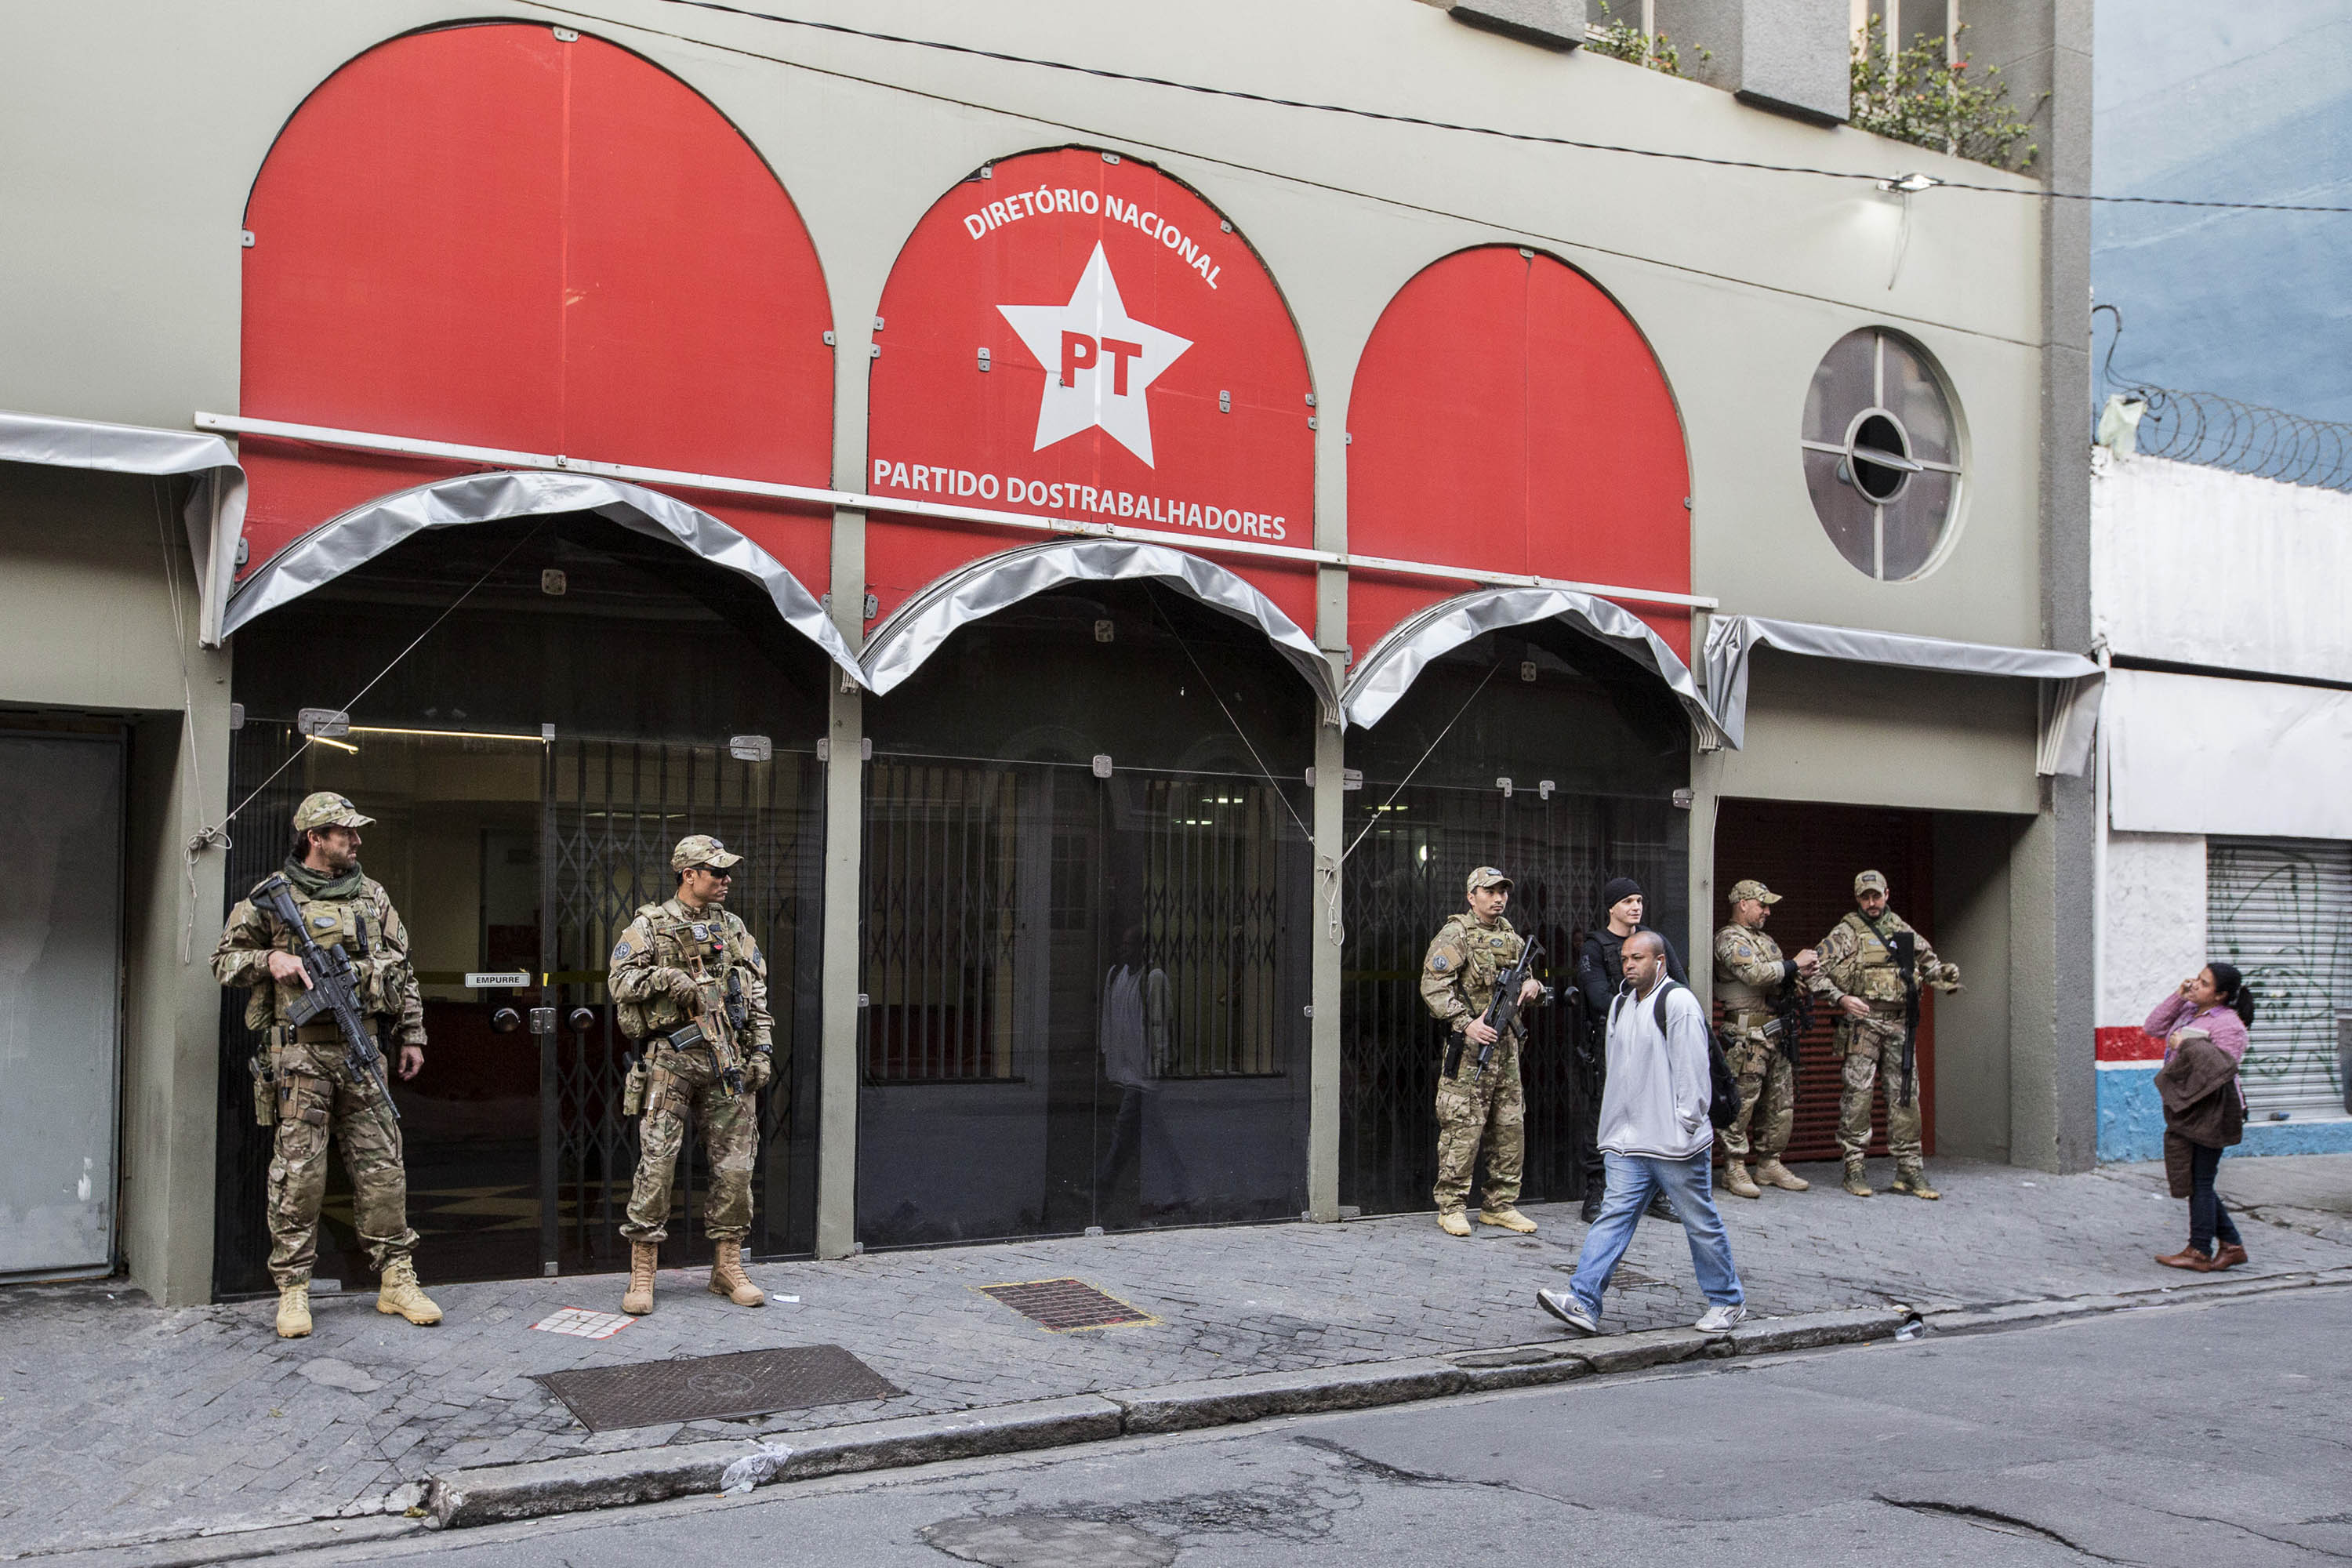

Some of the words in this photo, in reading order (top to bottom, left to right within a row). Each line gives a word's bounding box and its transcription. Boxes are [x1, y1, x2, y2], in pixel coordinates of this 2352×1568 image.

[964, 185, 1099, 241] DIRETÓRIO
[1105, 194, 1221, 290] NACIONAL
[1060, 329, 1142, 397] PT
[874, 459, 1000, 499] PARTIDO
